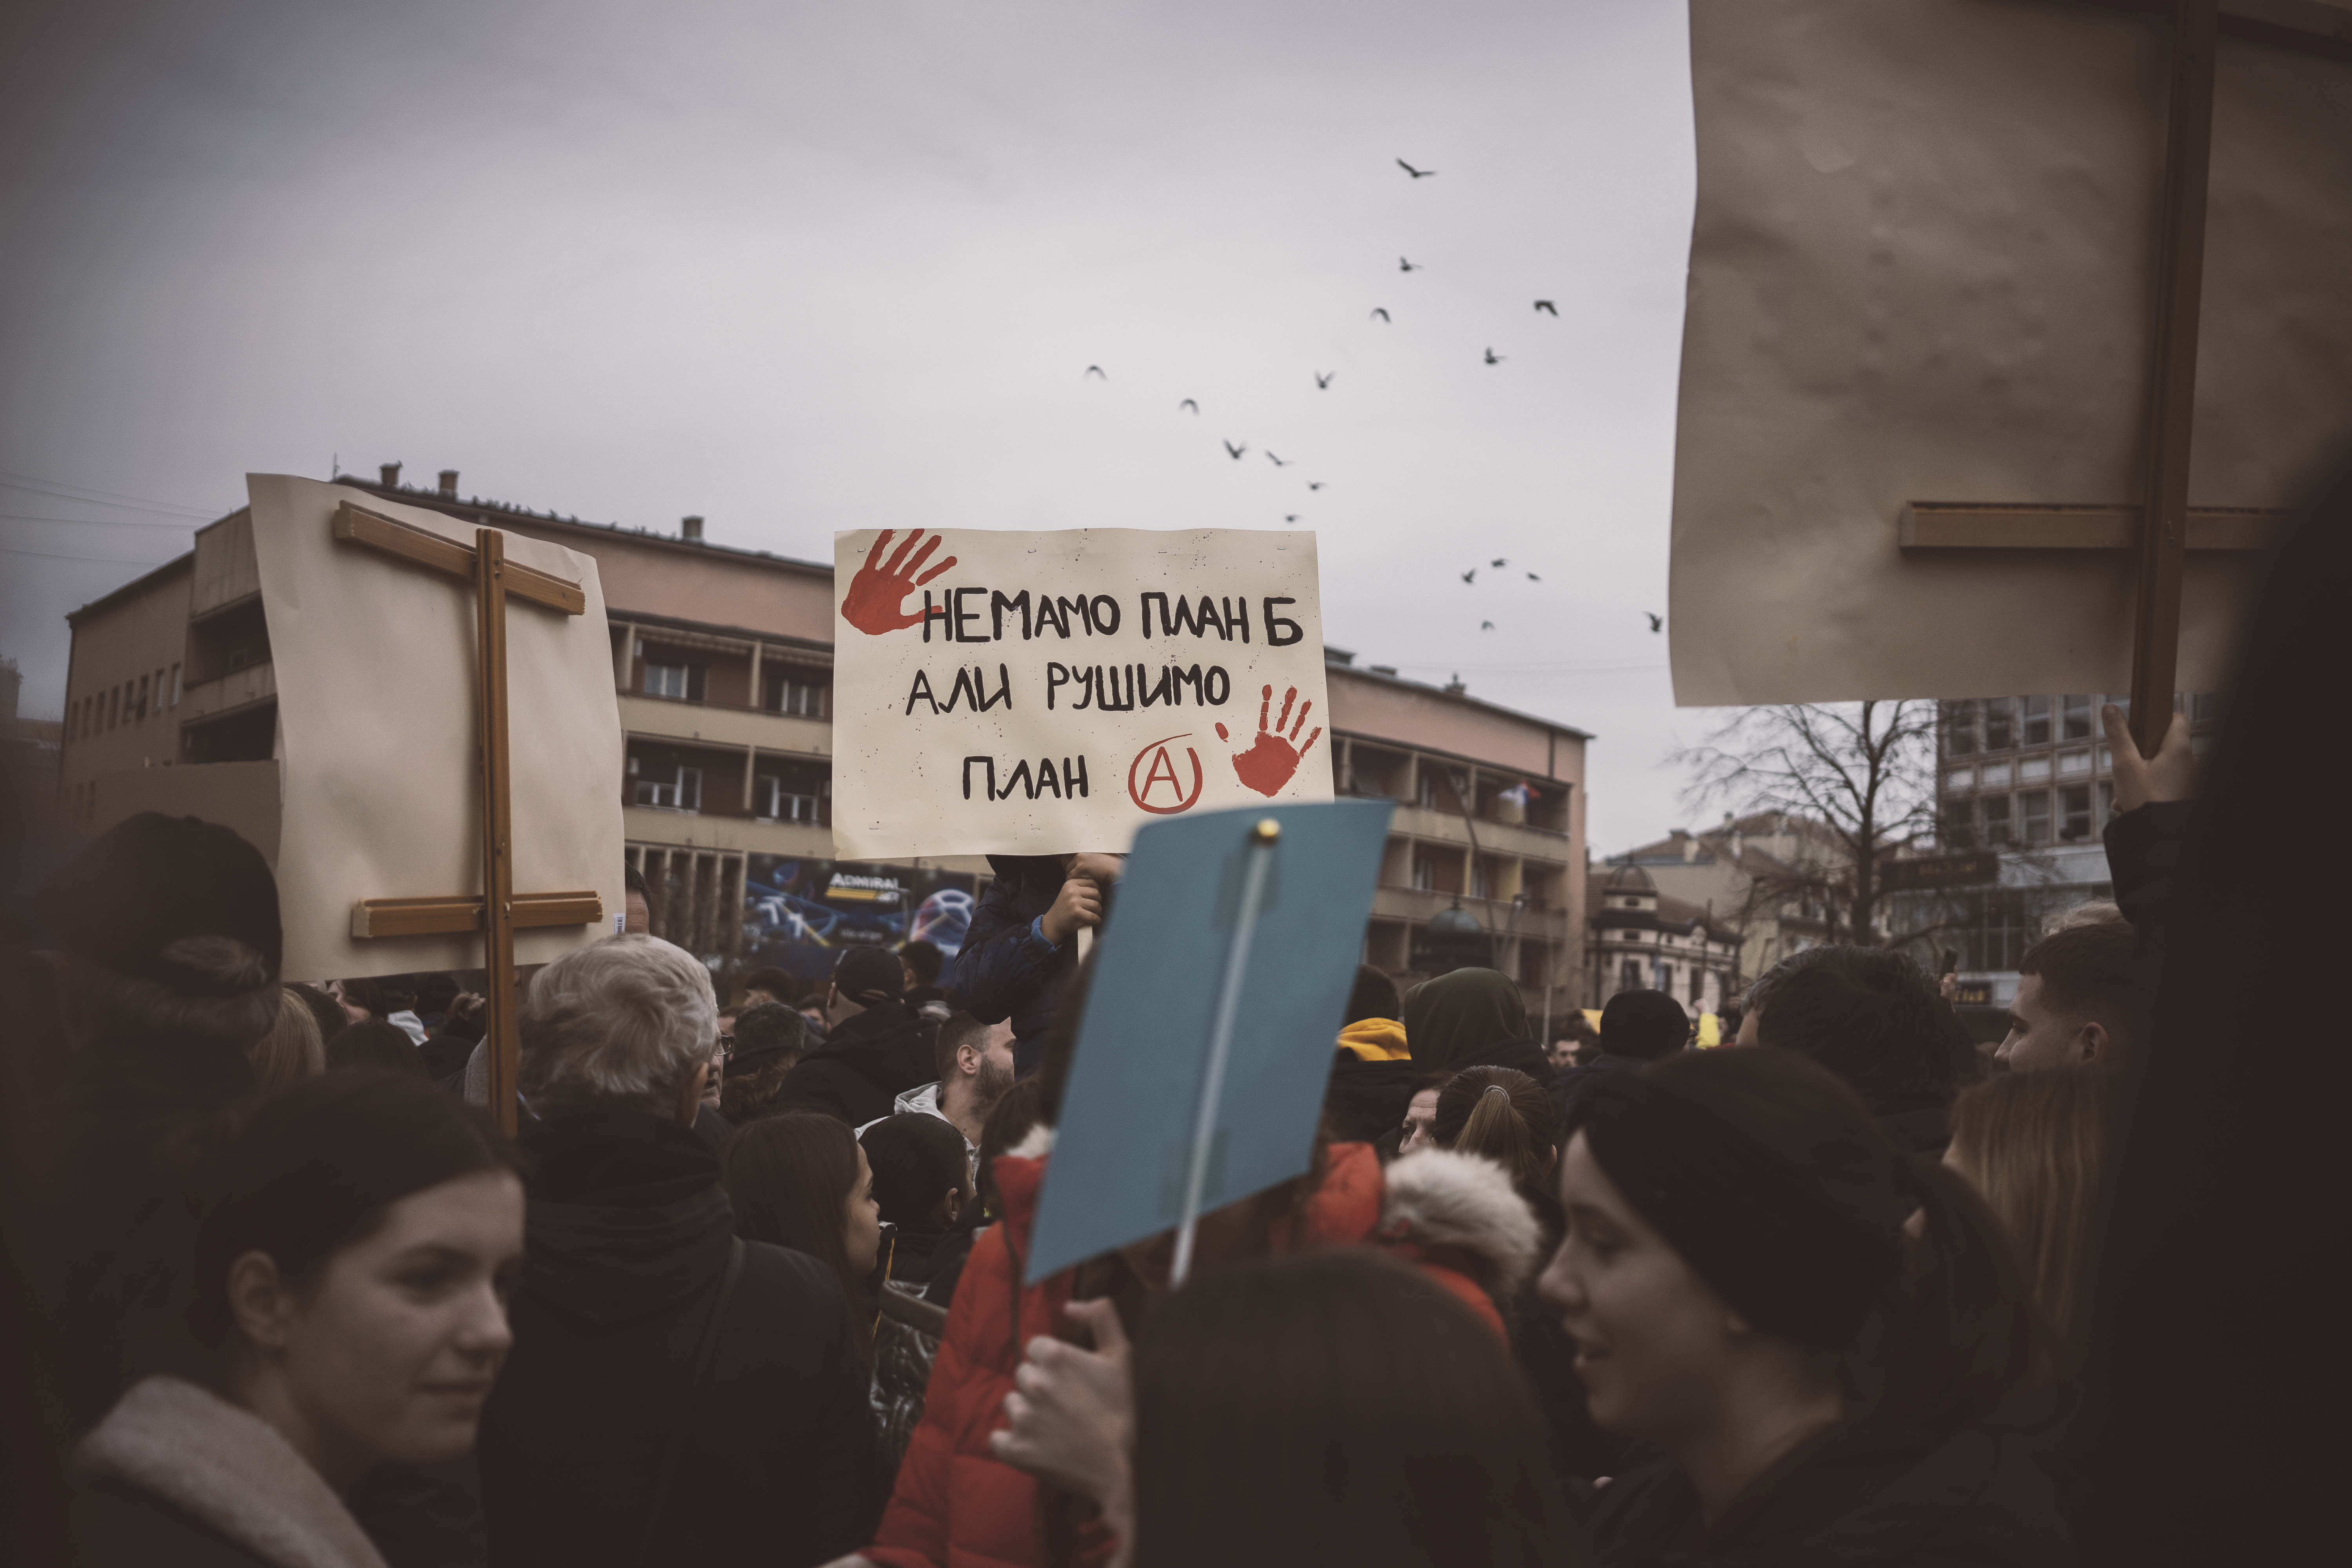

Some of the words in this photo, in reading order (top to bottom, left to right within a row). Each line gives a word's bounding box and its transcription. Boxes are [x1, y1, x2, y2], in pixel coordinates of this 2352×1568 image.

[923, 587, 1121, 643] НЕМАМО
[1140, 592, 1250, 644] ПЛАН
[1263, 597, 1303, 647] Б
[906, 663, 1012, 716] АЛИ
[1047, 662, 1230, 711] РУШИМО
[962, 755, 1088, 801] ПЛАН
